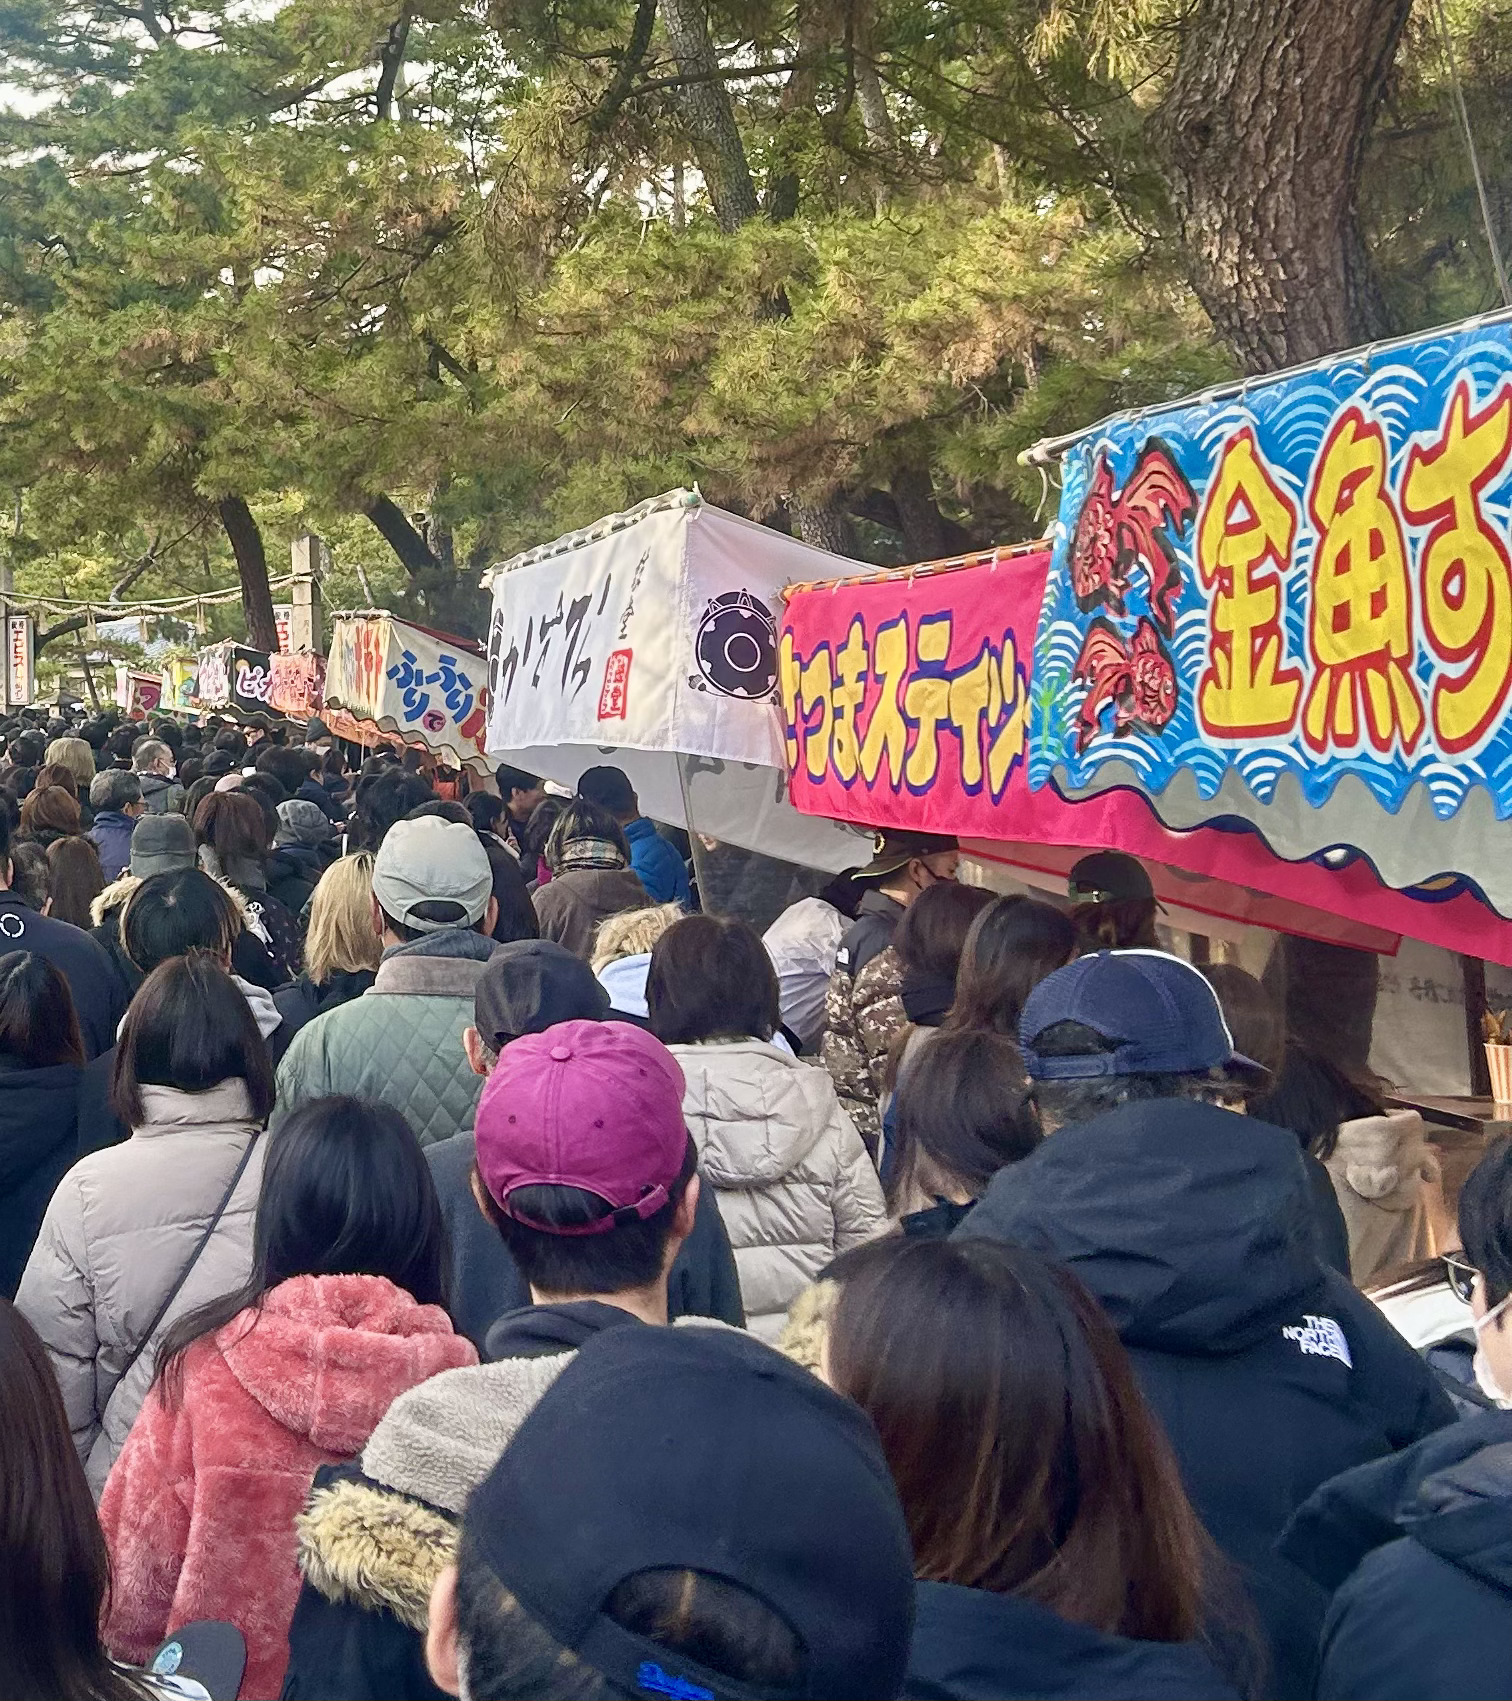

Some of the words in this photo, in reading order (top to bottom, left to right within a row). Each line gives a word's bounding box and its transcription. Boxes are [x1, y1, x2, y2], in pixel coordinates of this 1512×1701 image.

[1197, 376, 1512, 755] 金魚す
[780, 610, 1031, 807] つまスティッ
[1302, 1314, 1336, 1331] THE
[1282, 1325, 1337, 1347] NORTH
[1299, 1341, 1342, 1359] FACE
